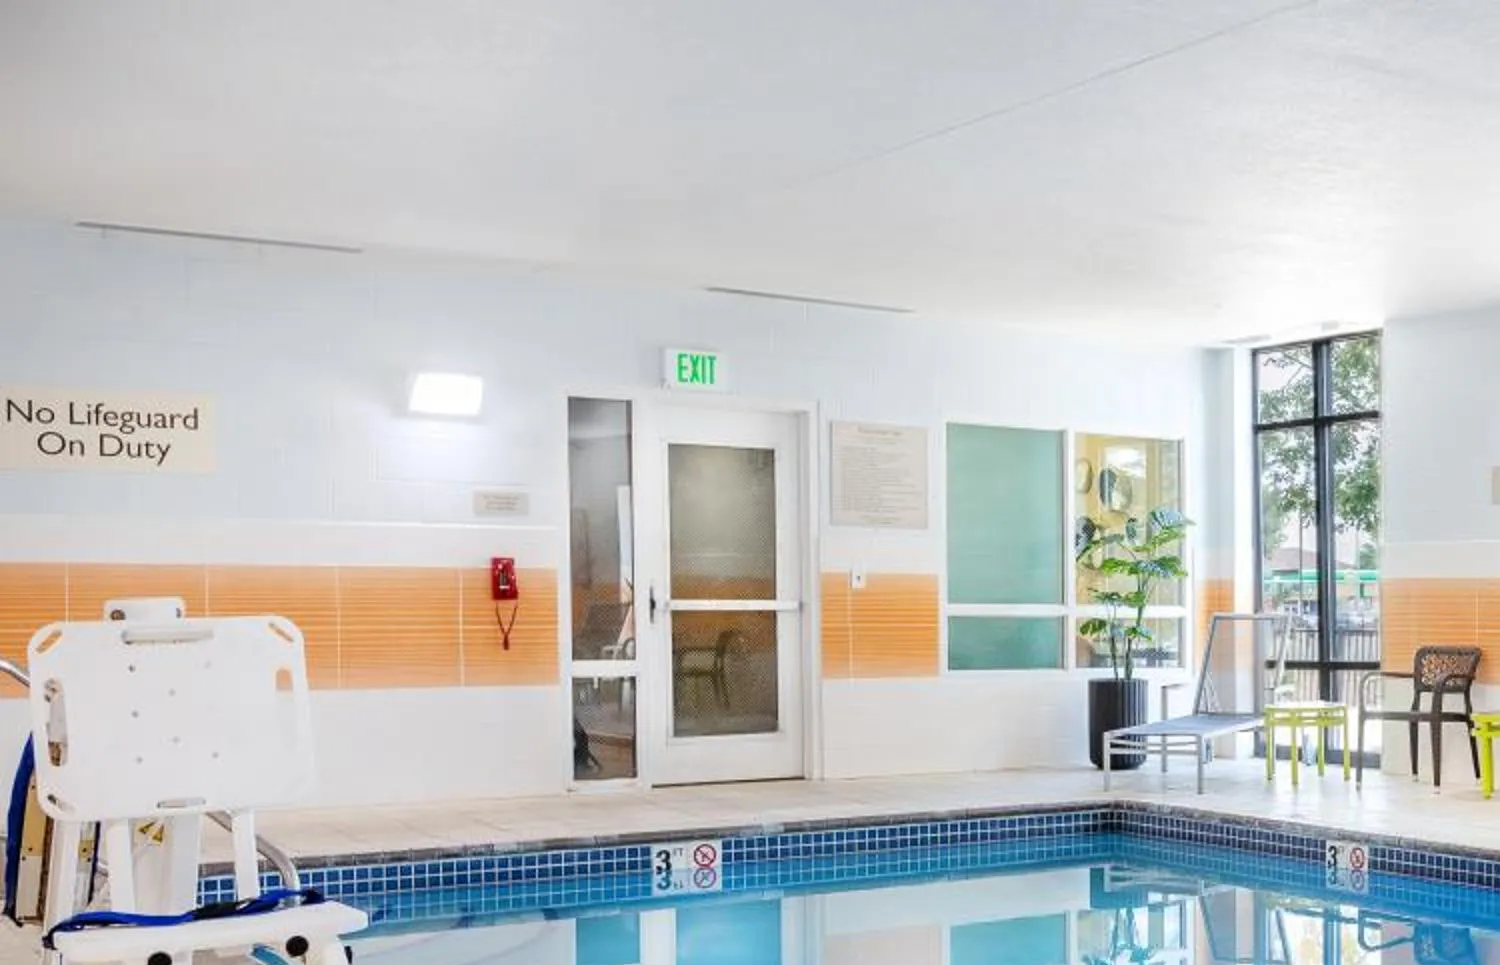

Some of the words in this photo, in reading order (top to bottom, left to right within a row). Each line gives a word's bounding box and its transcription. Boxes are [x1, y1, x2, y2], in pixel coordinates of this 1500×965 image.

[677, 353, 717, 385] EXIT
[6, 398, 56, 424] No
[69, 401, 199, 434] Lifeguard
[37, 431, 85, 456] On
[99, 433, 171, 466] Duty
[656, 849, 672, 874] 3
[1327, 845, 1337, 868] 3
